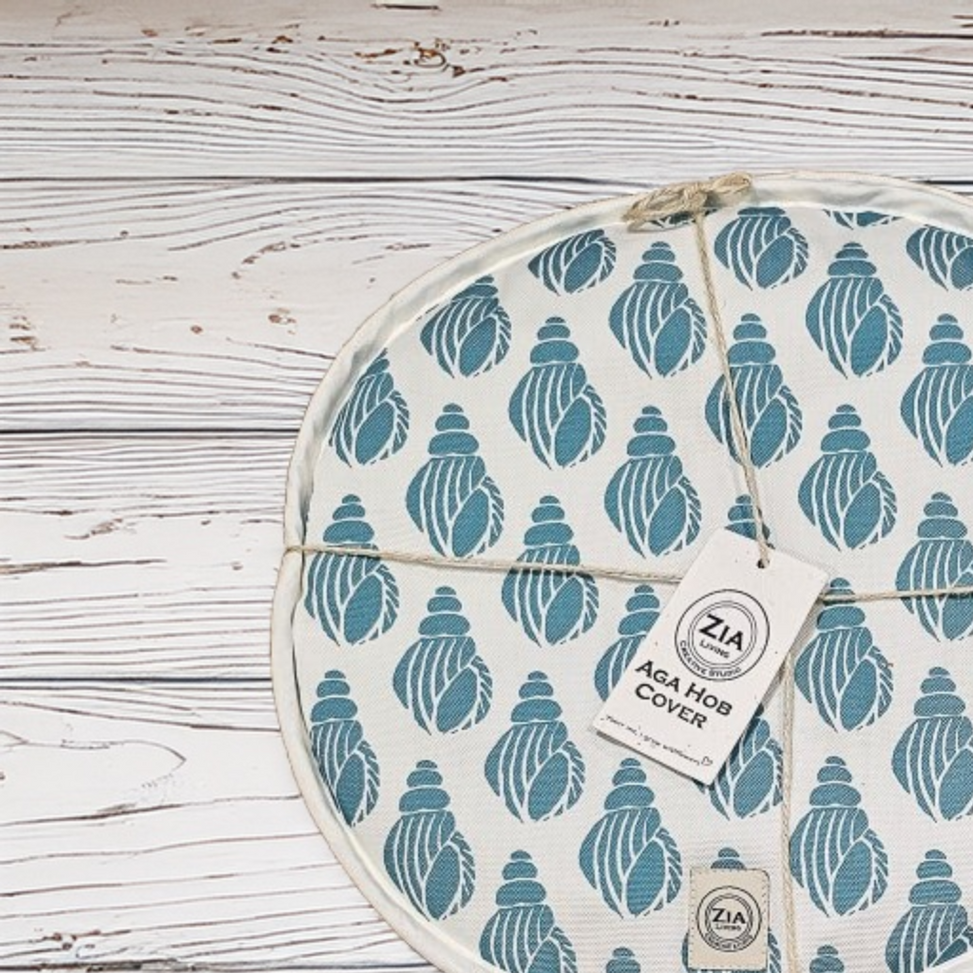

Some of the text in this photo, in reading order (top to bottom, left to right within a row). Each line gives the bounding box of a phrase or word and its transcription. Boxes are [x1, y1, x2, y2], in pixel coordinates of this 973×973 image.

[699, 613, 743, 651] ZIA
[635, 660, 732, 716] AGA HOB
[635, 683, 707, 728] COVER
[712, 907, 746, 924] ZIA
